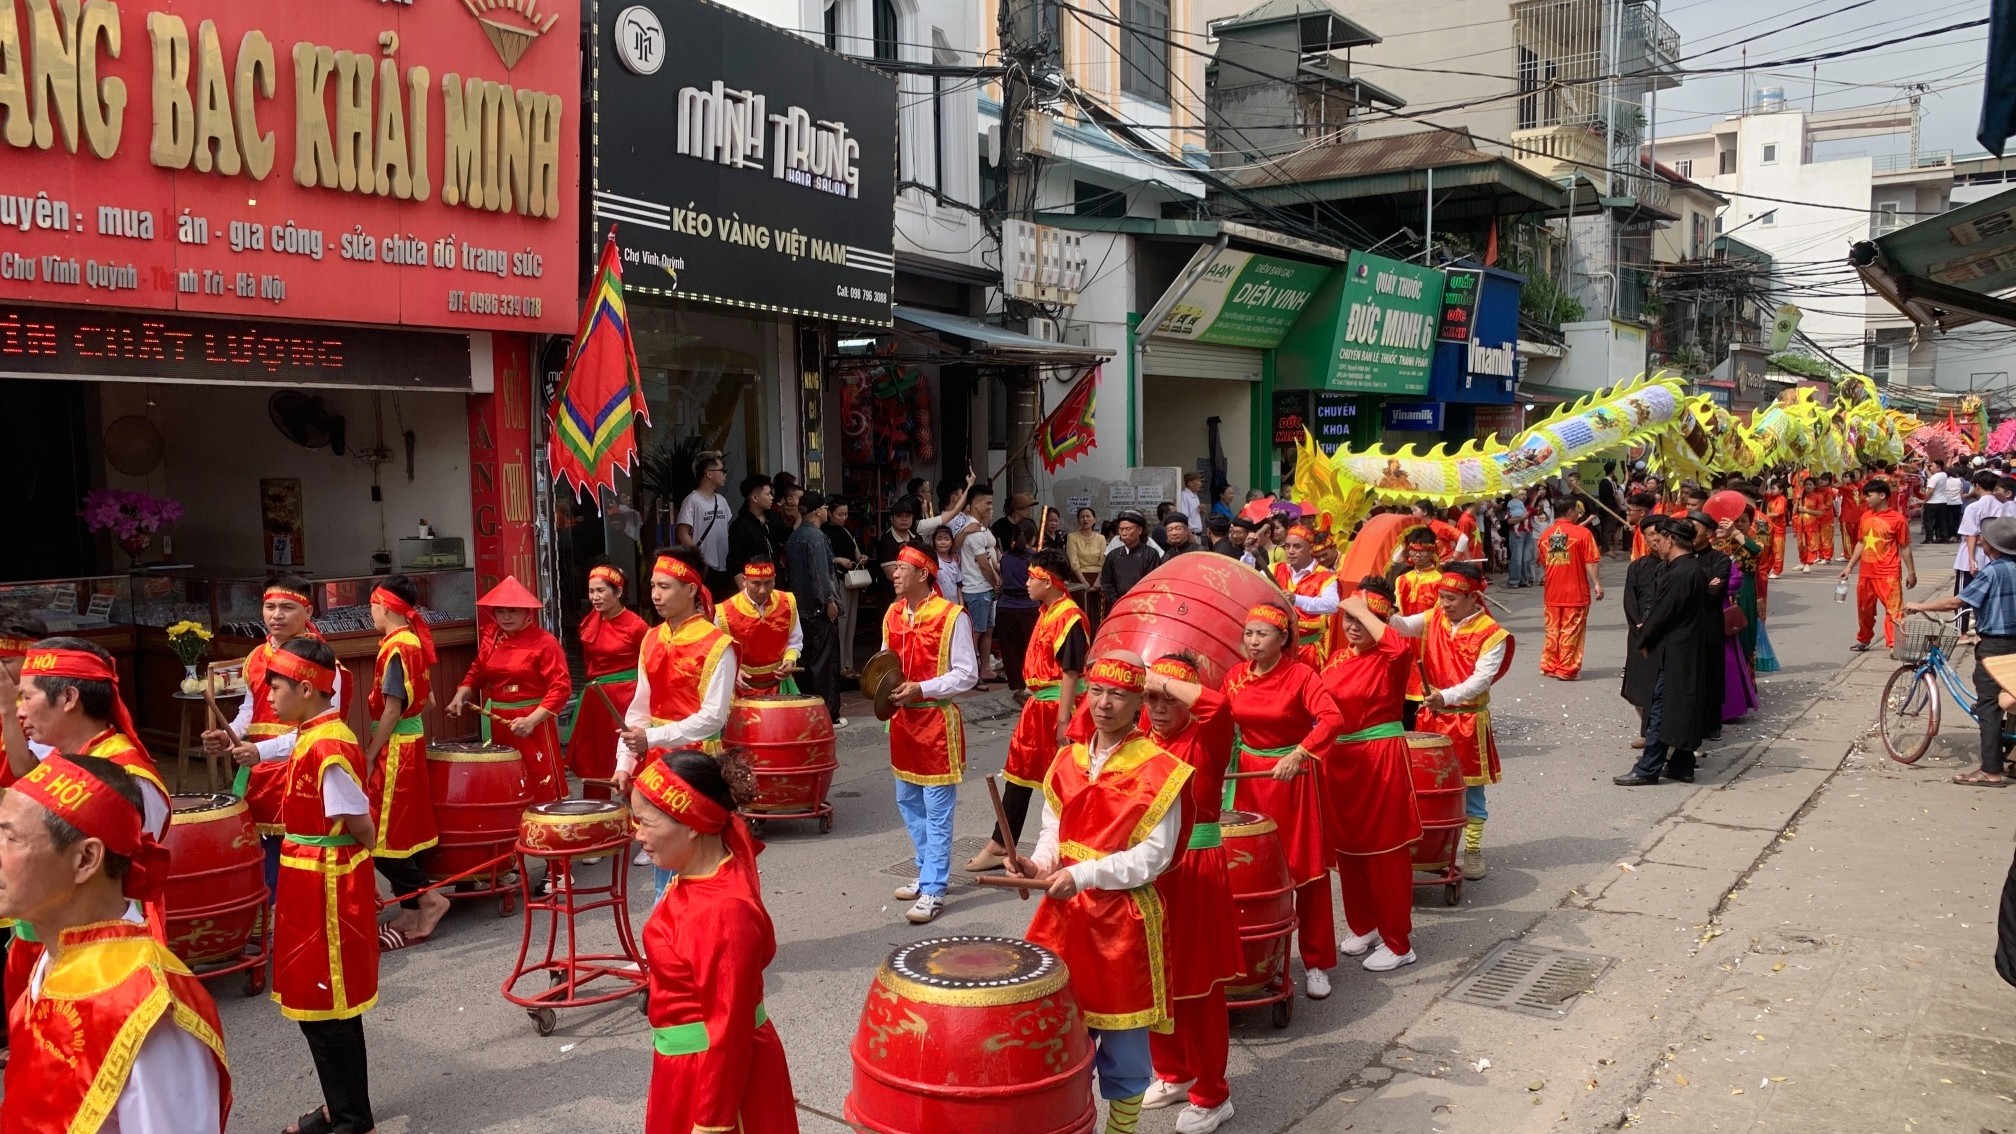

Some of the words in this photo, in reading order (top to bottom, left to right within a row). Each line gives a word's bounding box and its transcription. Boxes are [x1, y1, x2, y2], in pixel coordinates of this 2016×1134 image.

[292, 30, 430, 202] KHẢI
[442, 72, 562, 220] MINH
[788, 168, 811, 187] HAIR
[816, 176, 847, 197] SALON
[98, 205, 154, 240] mua
[229, 219, 265, 252] gia
[271, 219, 323, 260] công
[340, 224, 376, 262] sửa
[381, 233, 428, 266] chữa
[433, 233, 456, 269] đồ
[461, 242, 508, 278] trang
[513, 247, 544, 278] sức
[672, 200, 713, 238] KÉO
[717, 211, 770, 249] VÀNG
[774, 228, 808, 261] VIỆT
[810, 238, 846, 266] NAM
[624, 247, 640, 265] Chợ
[661, 253, 685, 270] Quỳnh
[41, 254, 81, 285] Vĩnh
[86, 260, 138, 291] Quỳnh
[236, 272, 256, 298] Hà
[261, 274, 286, 304] Nội
[1397, 273, 1422, 300] THUỐC
[448, 290, 467, 313] ĐT:
[469, 291, 498, 315] 0986
[499, 294, 521, 317] 339
[837, 284, 849, 297] Call:
[850, 287, 861, 300] 098
[862, 289, 873, 302] 796
[1272, 288, 1311, 311] VINH
[1345, 296, 1381, 345] ĐỨC
[1380, 309, 1423, 349] MINH
[1421, 315, 1433, 351] 6
[74, 322, 193, 362] CHẤT
[204, 329, 344, 373] LƯỢNG
[1361, 348, 1373, 362] BÁN
[1468, 337, 1514, 377] Vinamilk
[1317, 403, 1356, 417] CHUYÊN
[1392, 409, 1433, 420] Vinamilk
[1323, 424, 1350, 435] KHOA
[671, 562, 687, 577] HỘI
[32, 652, 57, 671] HỘI
[44, 773, 93, 812] HỘI
[660, 785, 692, 814] HỘI
